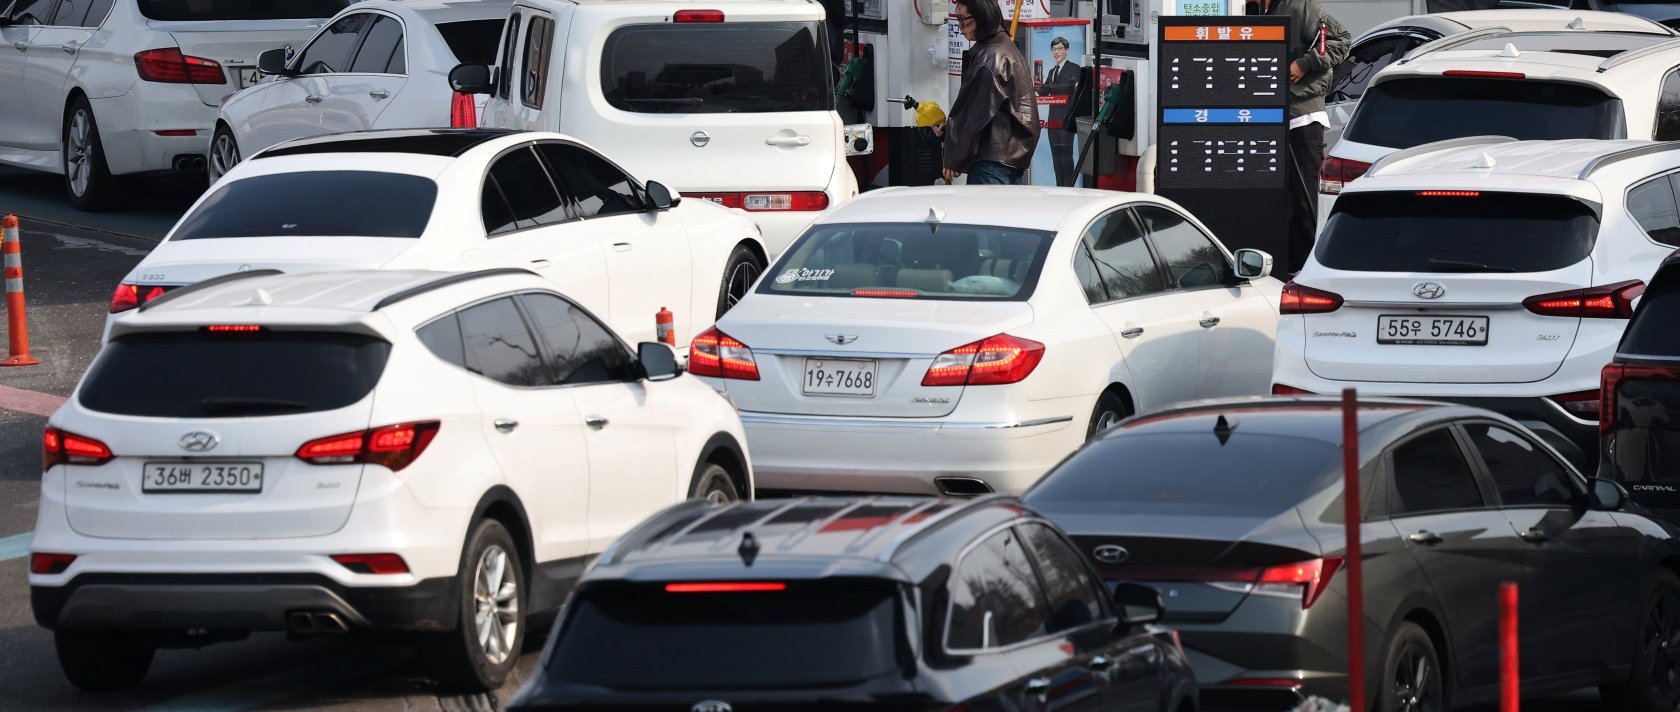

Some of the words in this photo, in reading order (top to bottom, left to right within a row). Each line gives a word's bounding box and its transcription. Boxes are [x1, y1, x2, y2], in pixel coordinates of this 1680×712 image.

[1183, 3, 1219, 13] 탄소중립
[1195, 26, 1254, 40] 휘발유
[1194, 109, 1252, 123] 경유
[1170, 140, 1277, 172] 1799
[1388, 319, 1421, 337] 55우
[1431, 320, 1477, 338] 5746
[808, 370, 873, 389] 19수7668
[154, 467, 192, 486] 36버
[201, 466, 251, 486] 2350
[1633, 484, 1677, 492] CARNIVAL
